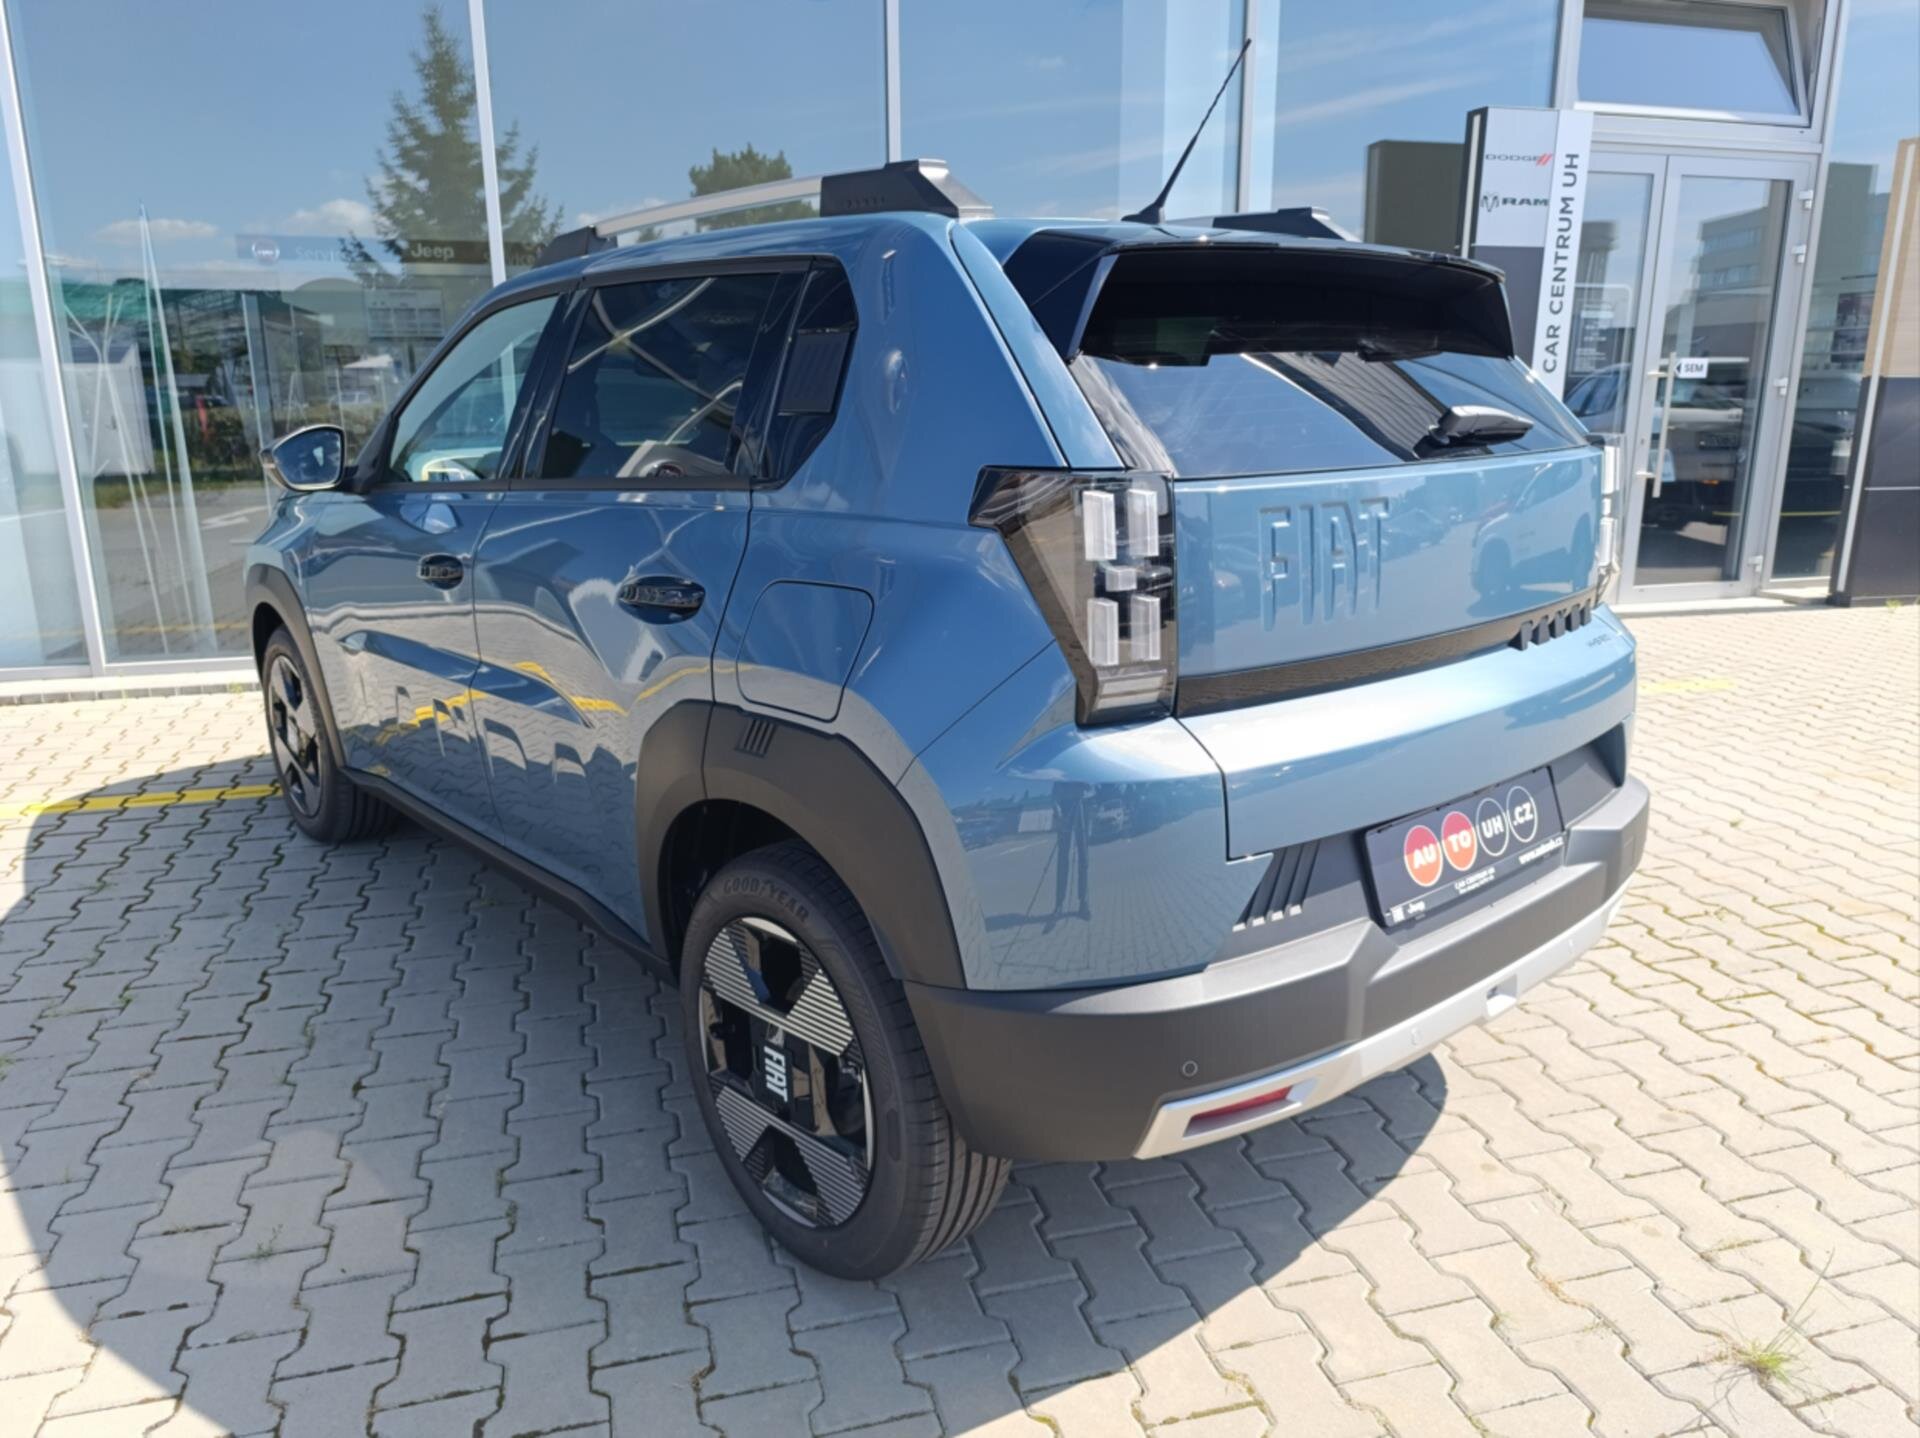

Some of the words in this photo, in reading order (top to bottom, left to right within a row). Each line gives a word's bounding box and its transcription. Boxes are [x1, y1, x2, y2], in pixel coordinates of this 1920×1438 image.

[1562, 153, 1579, 188] UH
[1501, 197, 1549, 207] RAM
[411, 243, 454, 260] Jeep
[1548, 196, 1575, 315] CENTRUM
[1542, 324, 1561, 374] CAR
[1259, 497, 1389, 633] FIAT
[1413, 844, 1437, 869] AU
[1448, 830, 1472, 853] TO
[1481, 815, 1504, 838] UH
[763, 1045, 789, 1103] FIAT
